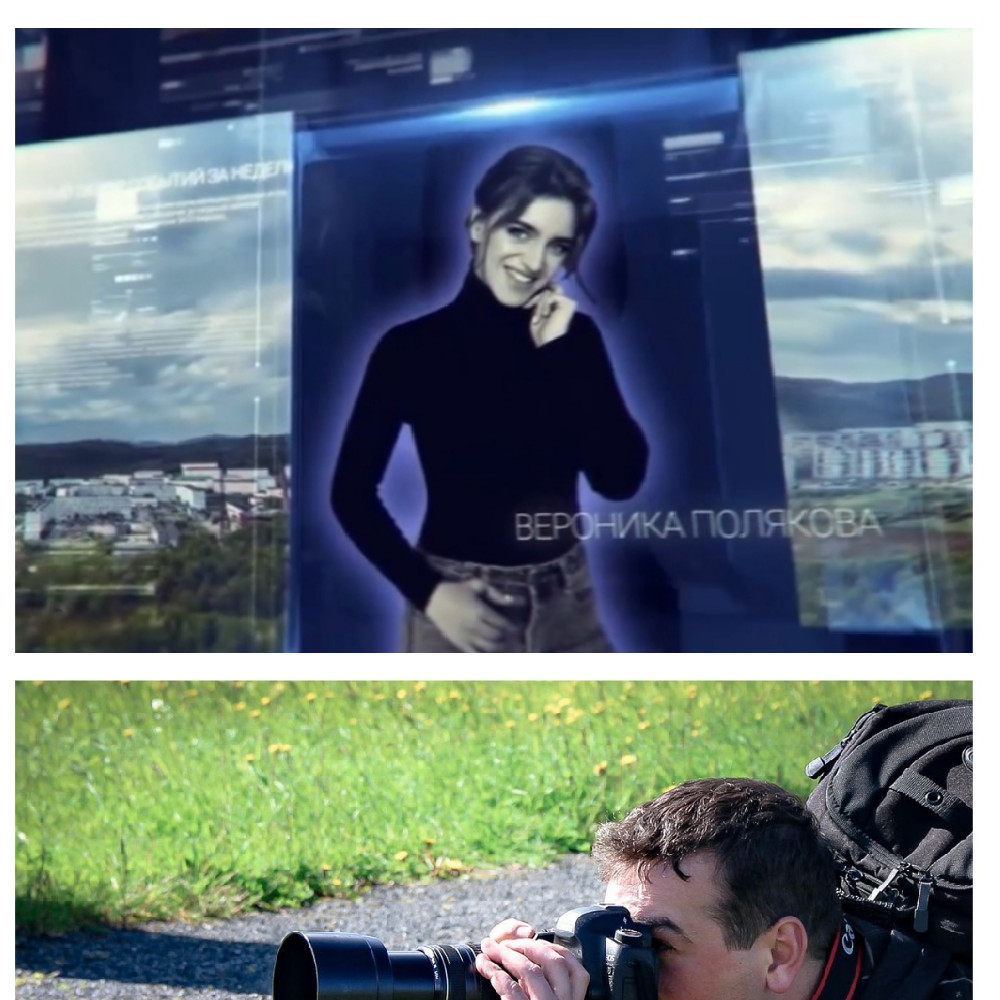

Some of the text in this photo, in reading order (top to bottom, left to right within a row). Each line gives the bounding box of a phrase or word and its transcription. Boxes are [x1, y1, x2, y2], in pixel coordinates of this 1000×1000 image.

[206, 166, 230, 184] ЗА
[515, 508, 885, 541] ВЕРОНИКА ПОЛЯКОВА
